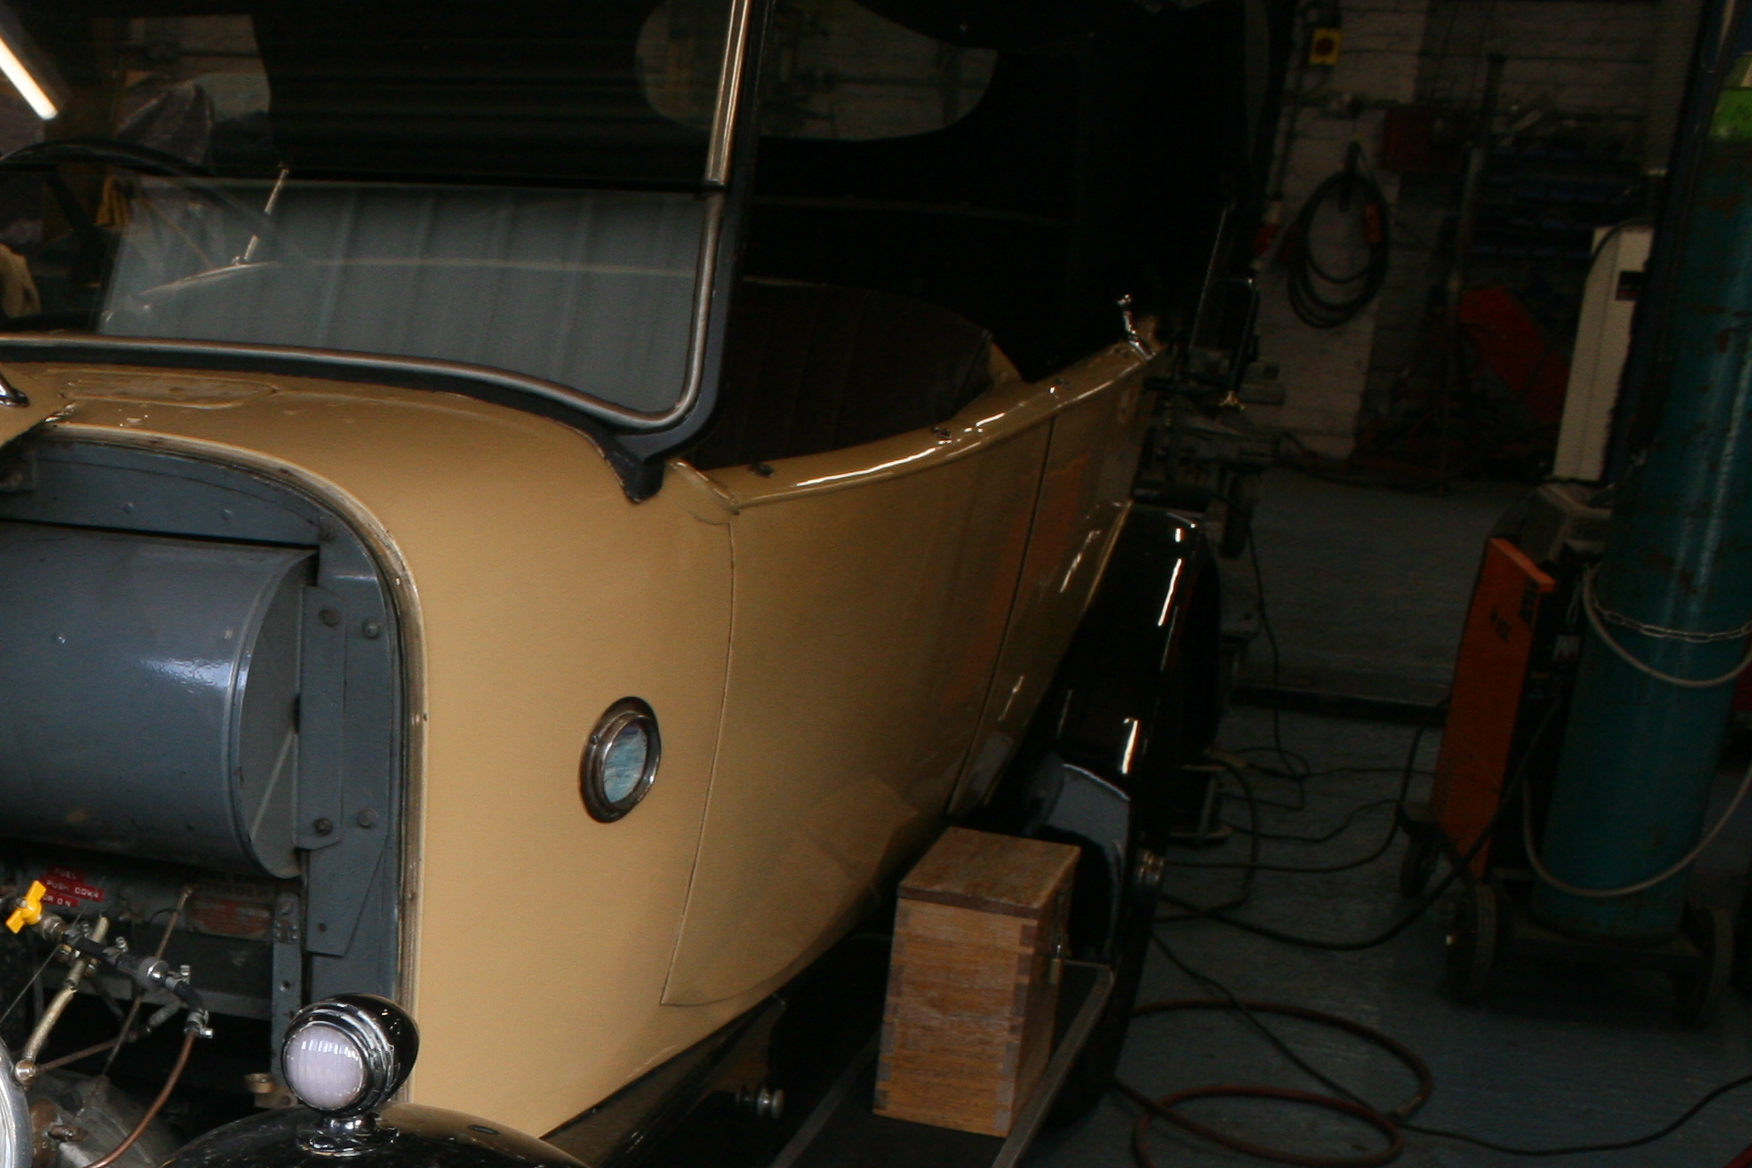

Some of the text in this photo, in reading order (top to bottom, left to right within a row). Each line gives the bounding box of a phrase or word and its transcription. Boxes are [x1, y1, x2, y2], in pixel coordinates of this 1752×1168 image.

[54, 868, 77, 880] FUEL
[46, 879, 99, 898] PUSH DOWN
[56, 898, 72, 908] ON
